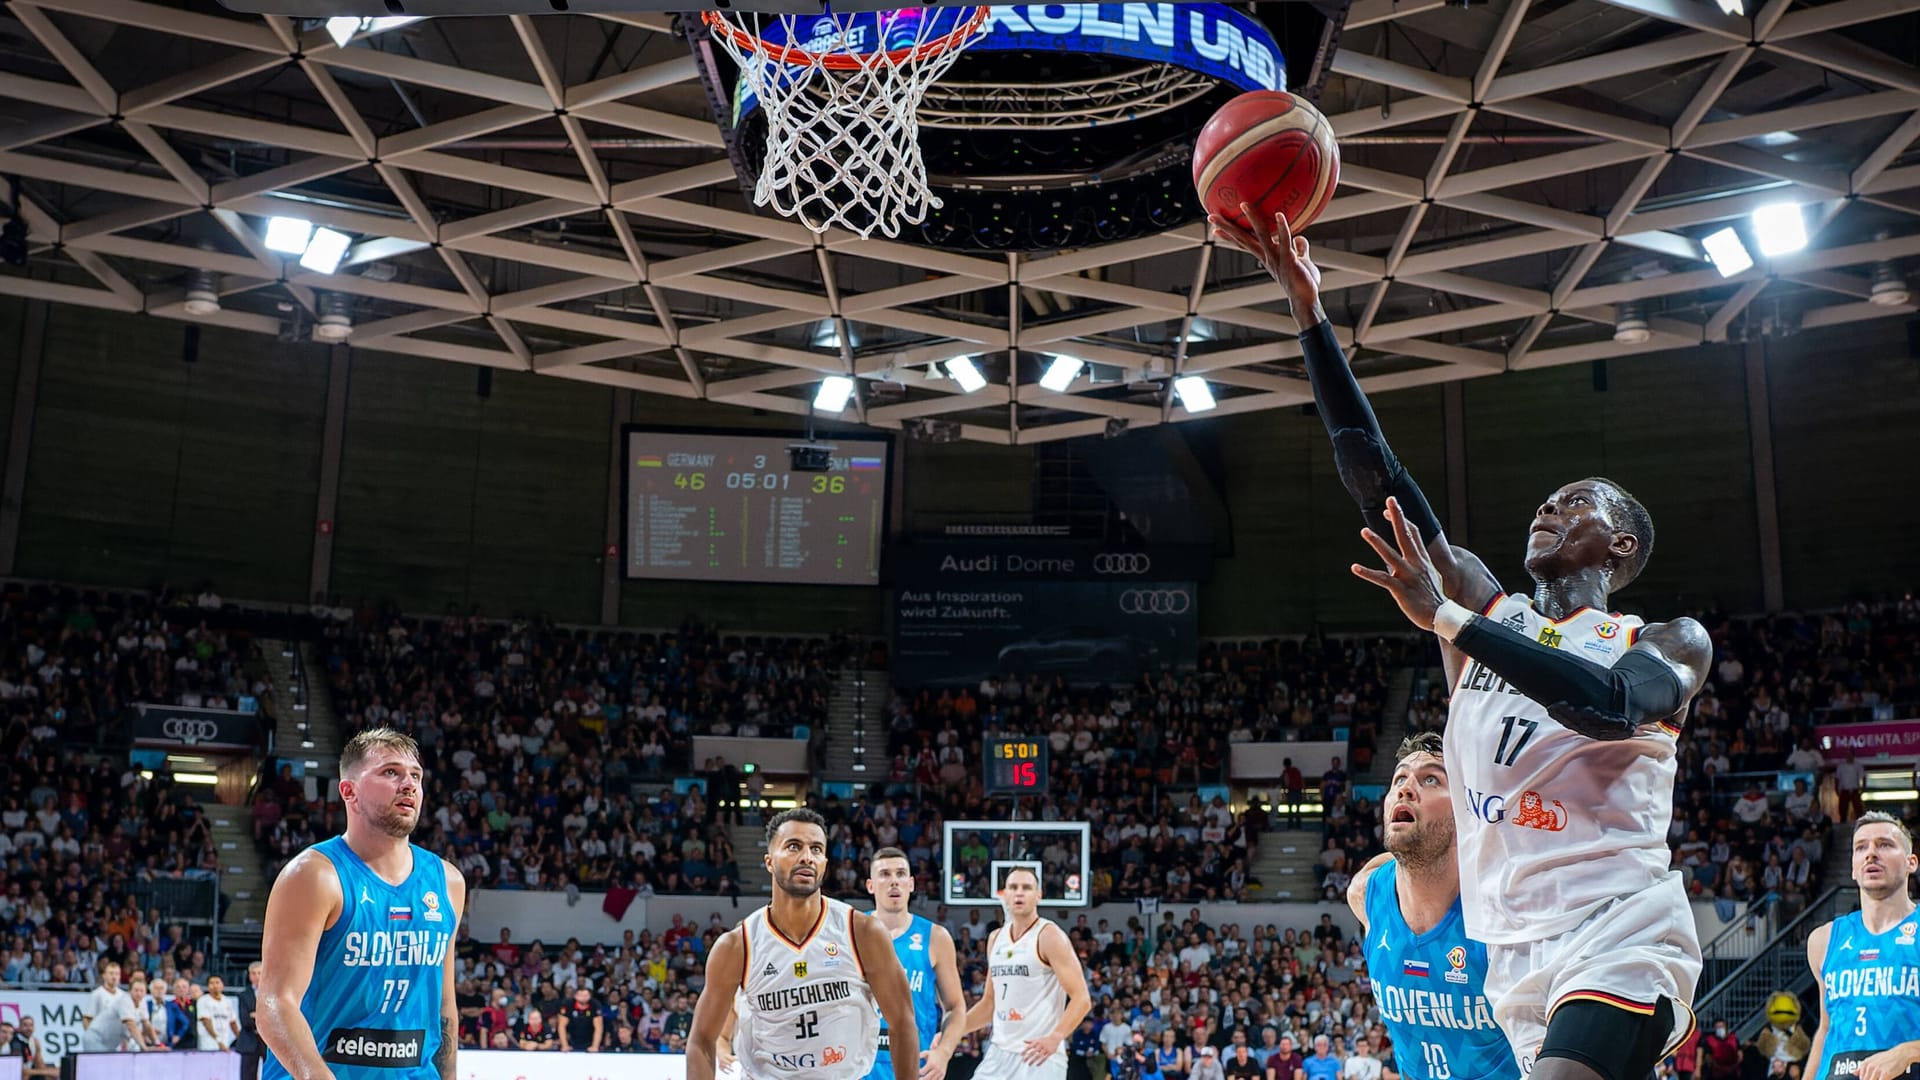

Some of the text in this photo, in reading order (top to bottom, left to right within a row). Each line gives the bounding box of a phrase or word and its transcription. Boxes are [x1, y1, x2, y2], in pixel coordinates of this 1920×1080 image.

[754, 455, 766, 469] 3
[674, 473, 705, 491] 46
[726, 473, 789, 490] 05:01
[812, 475, 845, 494] 36
[940, 555, 1075, 572] Audi Dome
[901, 590, 1023, 604] Aus Inspiration
[901, 606, 1012, 619] wird Zukunft.
[1493, 716, 1538, 767] 17
[1835, 733, 1902, 748] MAGENTA
[1013, 762, 1037, 787] 15
[757, 980, 851, 1011] DEUTSCHLAND
[1824, 966, 1920, 1001] SLOVENIJA
[380, 980, 410, 1014] 77
[1371, 978, 1496, 1030] SLOVENIJA
[795, 1010, 820, 1040] 32
[1855, 1006, 1867, 1036] 3
[336, 1036, 418, 1059] telemach
[773, 1052, 816, 1070] ING
[1421, 1041, 1451, 1080] 10
